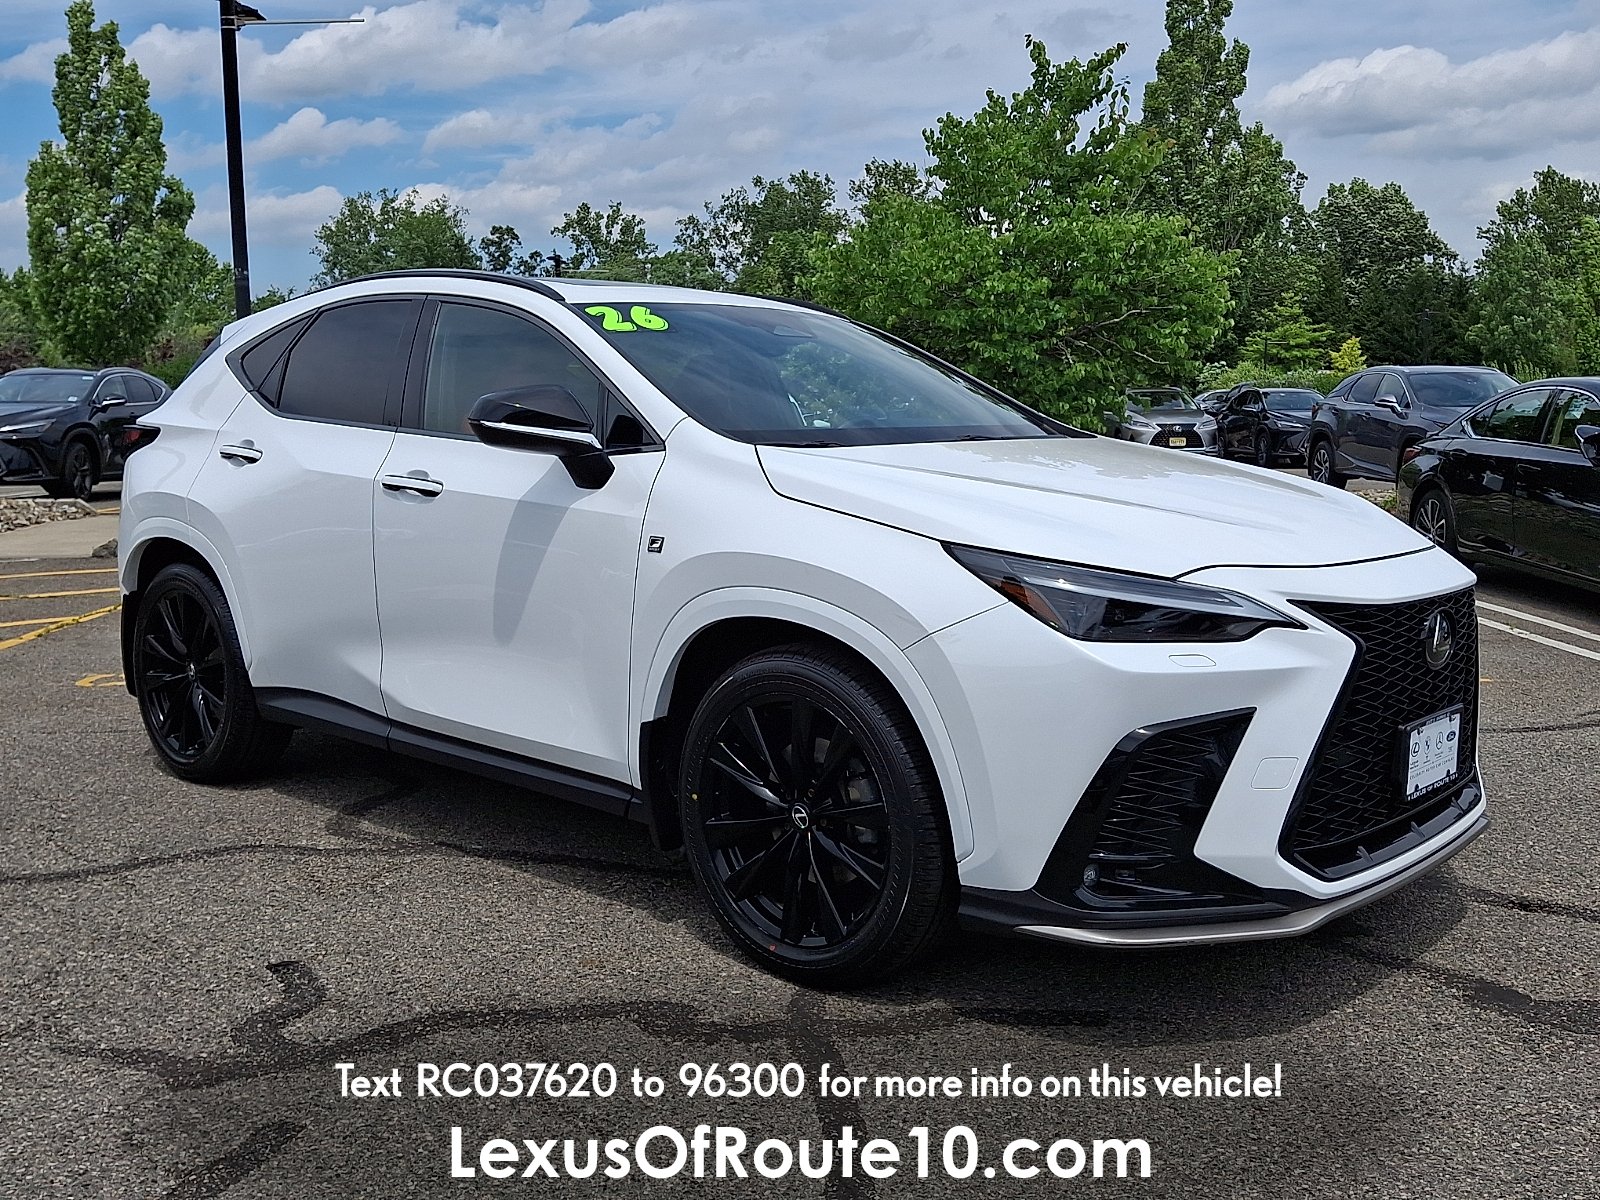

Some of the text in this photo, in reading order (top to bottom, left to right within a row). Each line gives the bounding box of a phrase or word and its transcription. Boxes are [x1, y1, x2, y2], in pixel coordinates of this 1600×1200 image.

[584, 305, 669, 332] 26
[1411, 788, 1427, 800] LEXUS
[1434, 777, 1449, 789] ROUTE
